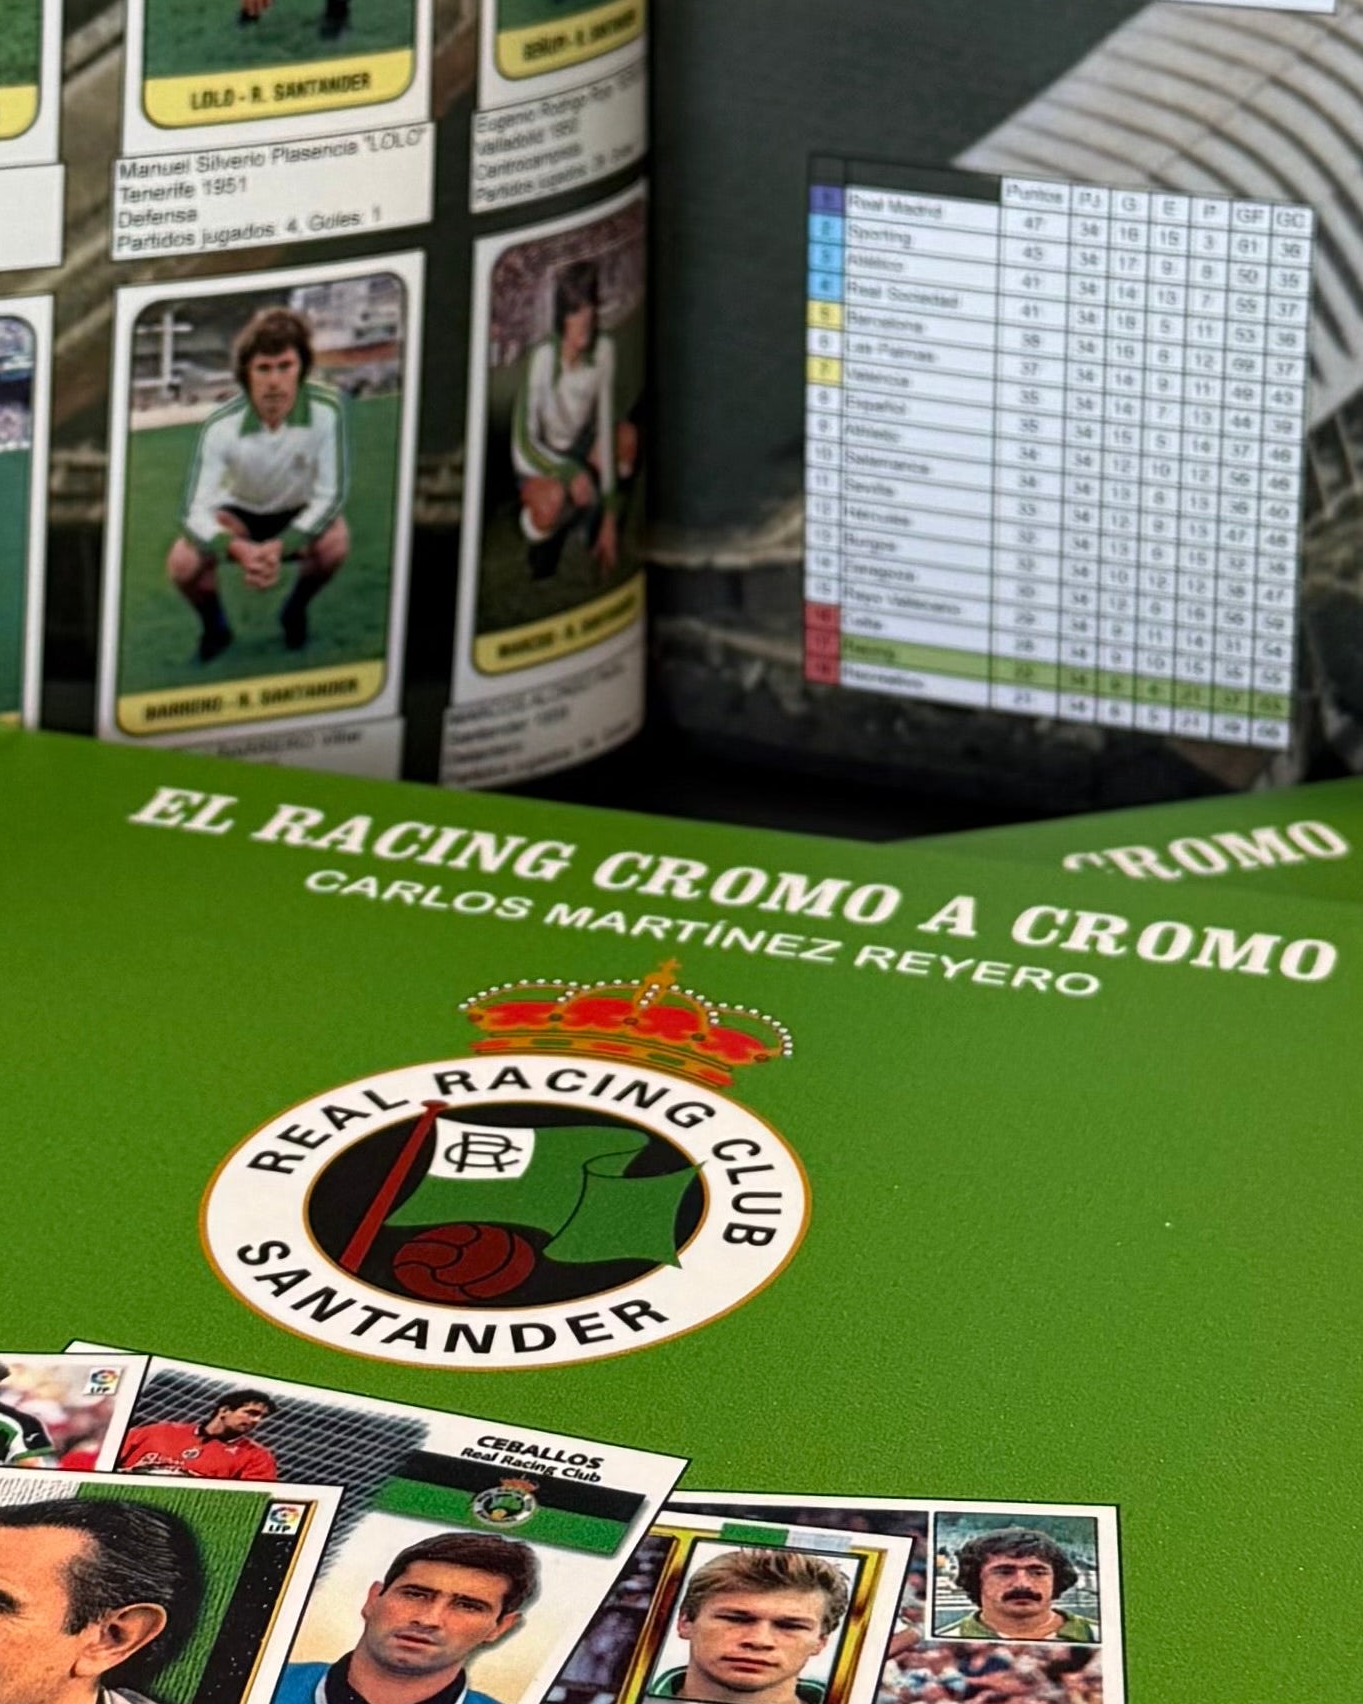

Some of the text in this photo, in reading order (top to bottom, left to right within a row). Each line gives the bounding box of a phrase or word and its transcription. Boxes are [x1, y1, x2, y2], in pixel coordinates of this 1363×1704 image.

[128, 786, 1339, 982] EL RACING CROMO A CROMO
[304, 869, 1102, 997] CARLOS MARTÍNEZ REYERO
[247, 1066, 782, 1247] REAL RACING CLUB
[236, 1240, 670, 1355] SANTANDER
[461, 1448, 601, 1483] Real Racing Club
[477, 1436, 605, 1469] CEBALLOS
